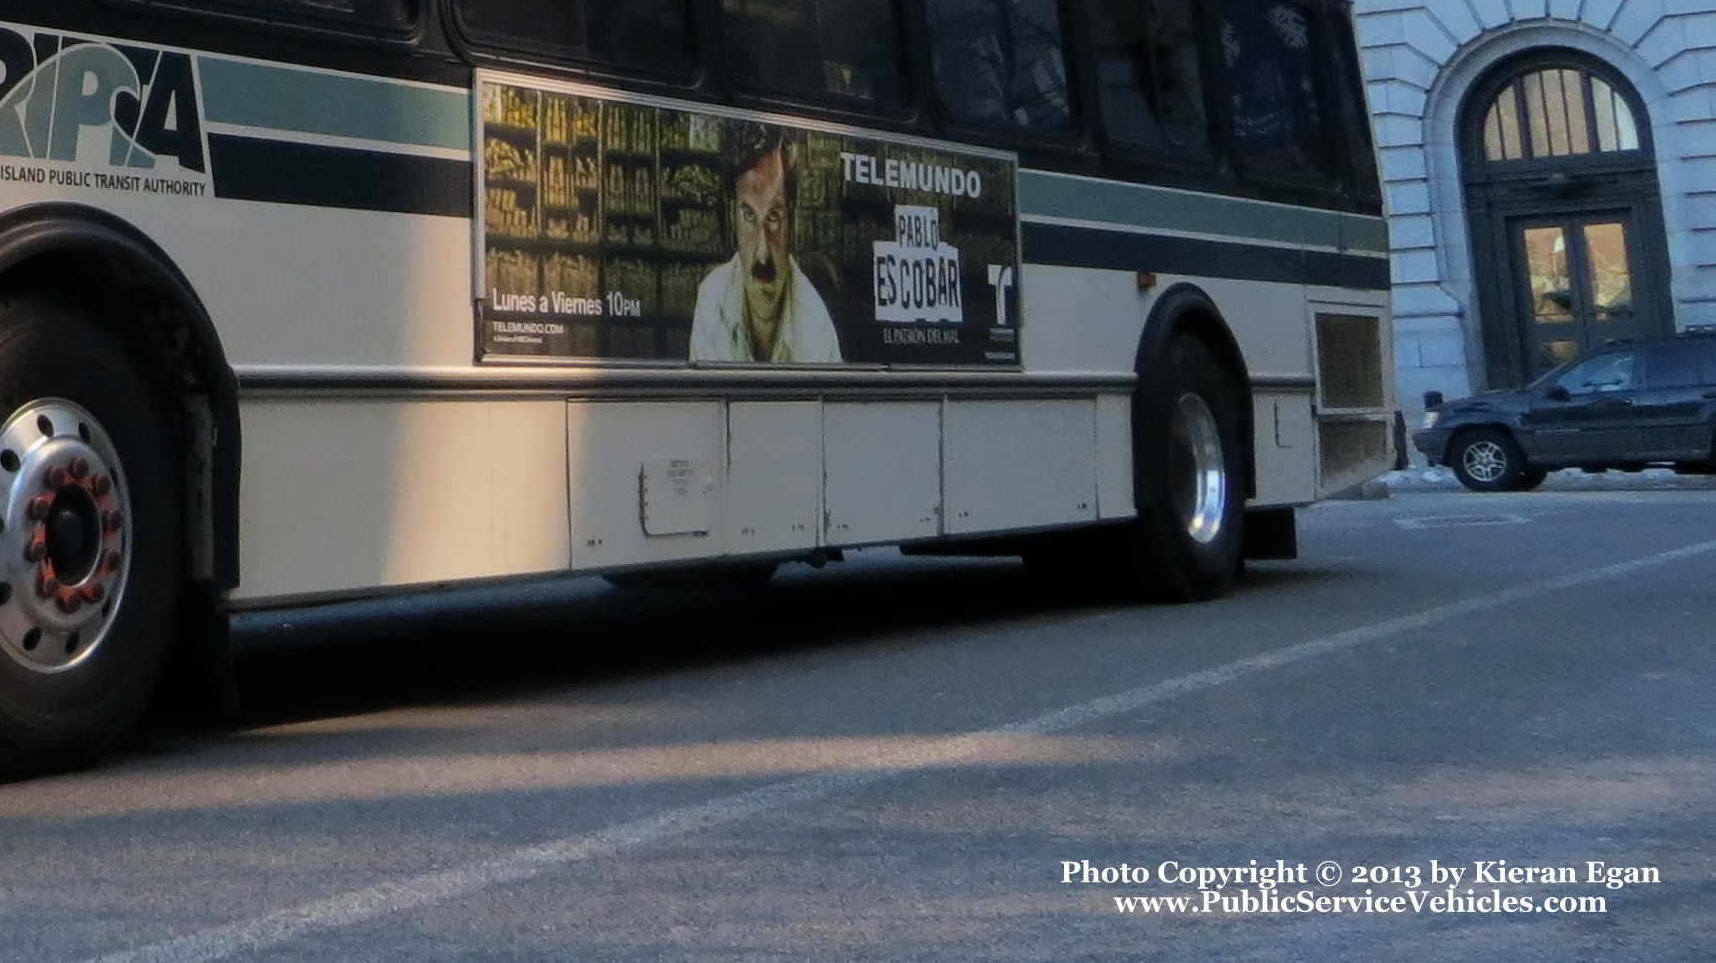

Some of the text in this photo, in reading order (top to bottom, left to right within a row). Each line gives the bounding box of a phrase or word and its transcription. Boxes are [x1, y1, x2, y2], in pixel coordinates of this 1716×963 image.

[0, 165, 45, 184] ISLAND
[49, 169, 91, 187] PUBLIC
[94, 173, 141, 191] TRANSIT
[143, 178, 206, 197] AUTHORITY
[840, 151, 982, 199] TELEMUNDO
[898, 214, 939, 252] PABLO
[876, 252, 959, 309] ESCOBAR
[492, 287, 536, 313] Lunes
[539, 295, 549, 314] a
[552, 290, 603, 316] Viernes
[492, 320, 564, 334] TELEMUNDO.COM
